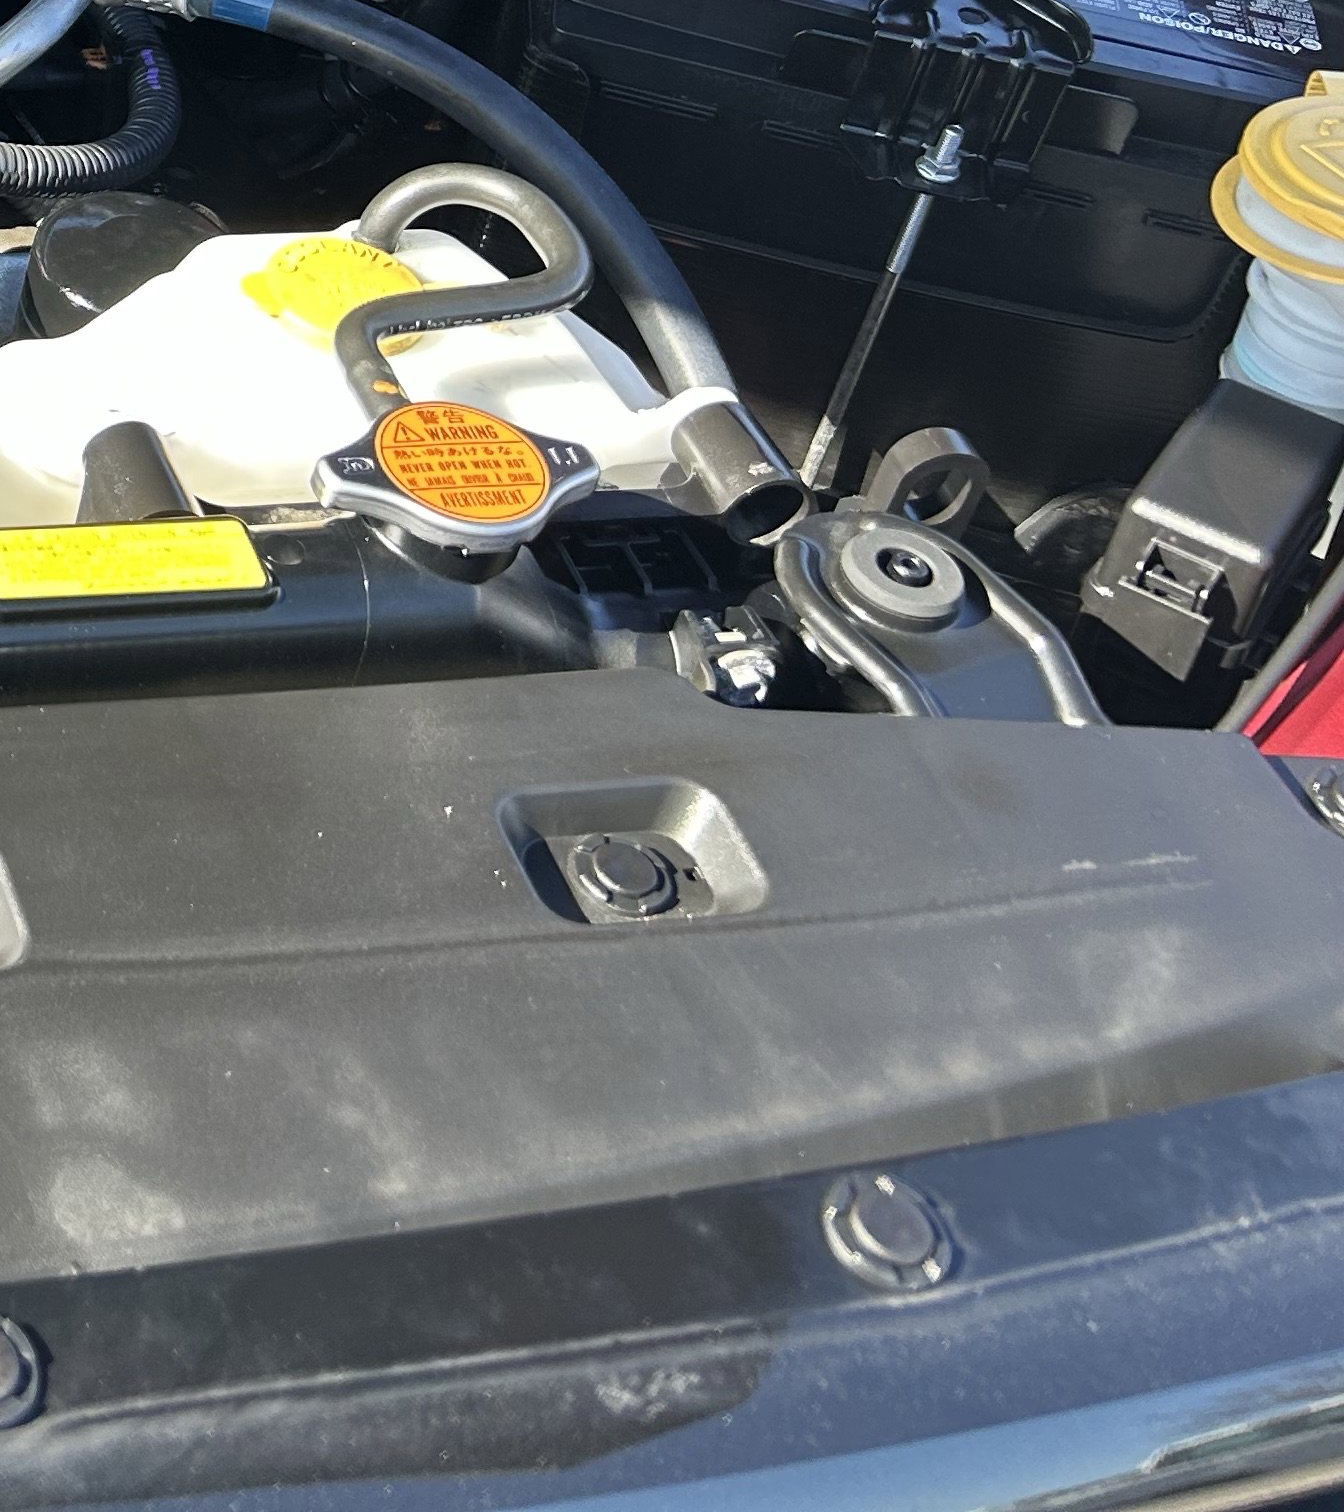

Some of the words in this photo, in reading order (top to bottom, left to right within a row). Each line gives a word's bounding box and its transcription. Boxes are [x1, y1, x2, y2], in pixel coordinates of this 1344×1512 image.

[1137, 10, 1285, 52] DANGER/POISON
[416, 409, 465, 425] 警告
[423, 424, 499, 441] WARNING
[399, 461, 435, 474] NEVER
[438, 460, 467, 472] OPEN
[470, 459, 502, 470] WHEN
[506, 458, 527, 469] HOT
[406, 476, 420, 488] NE
[424, 475, 457, 486] JAMAIS
[440, 488, 526, 509] AVERTISSMENT
